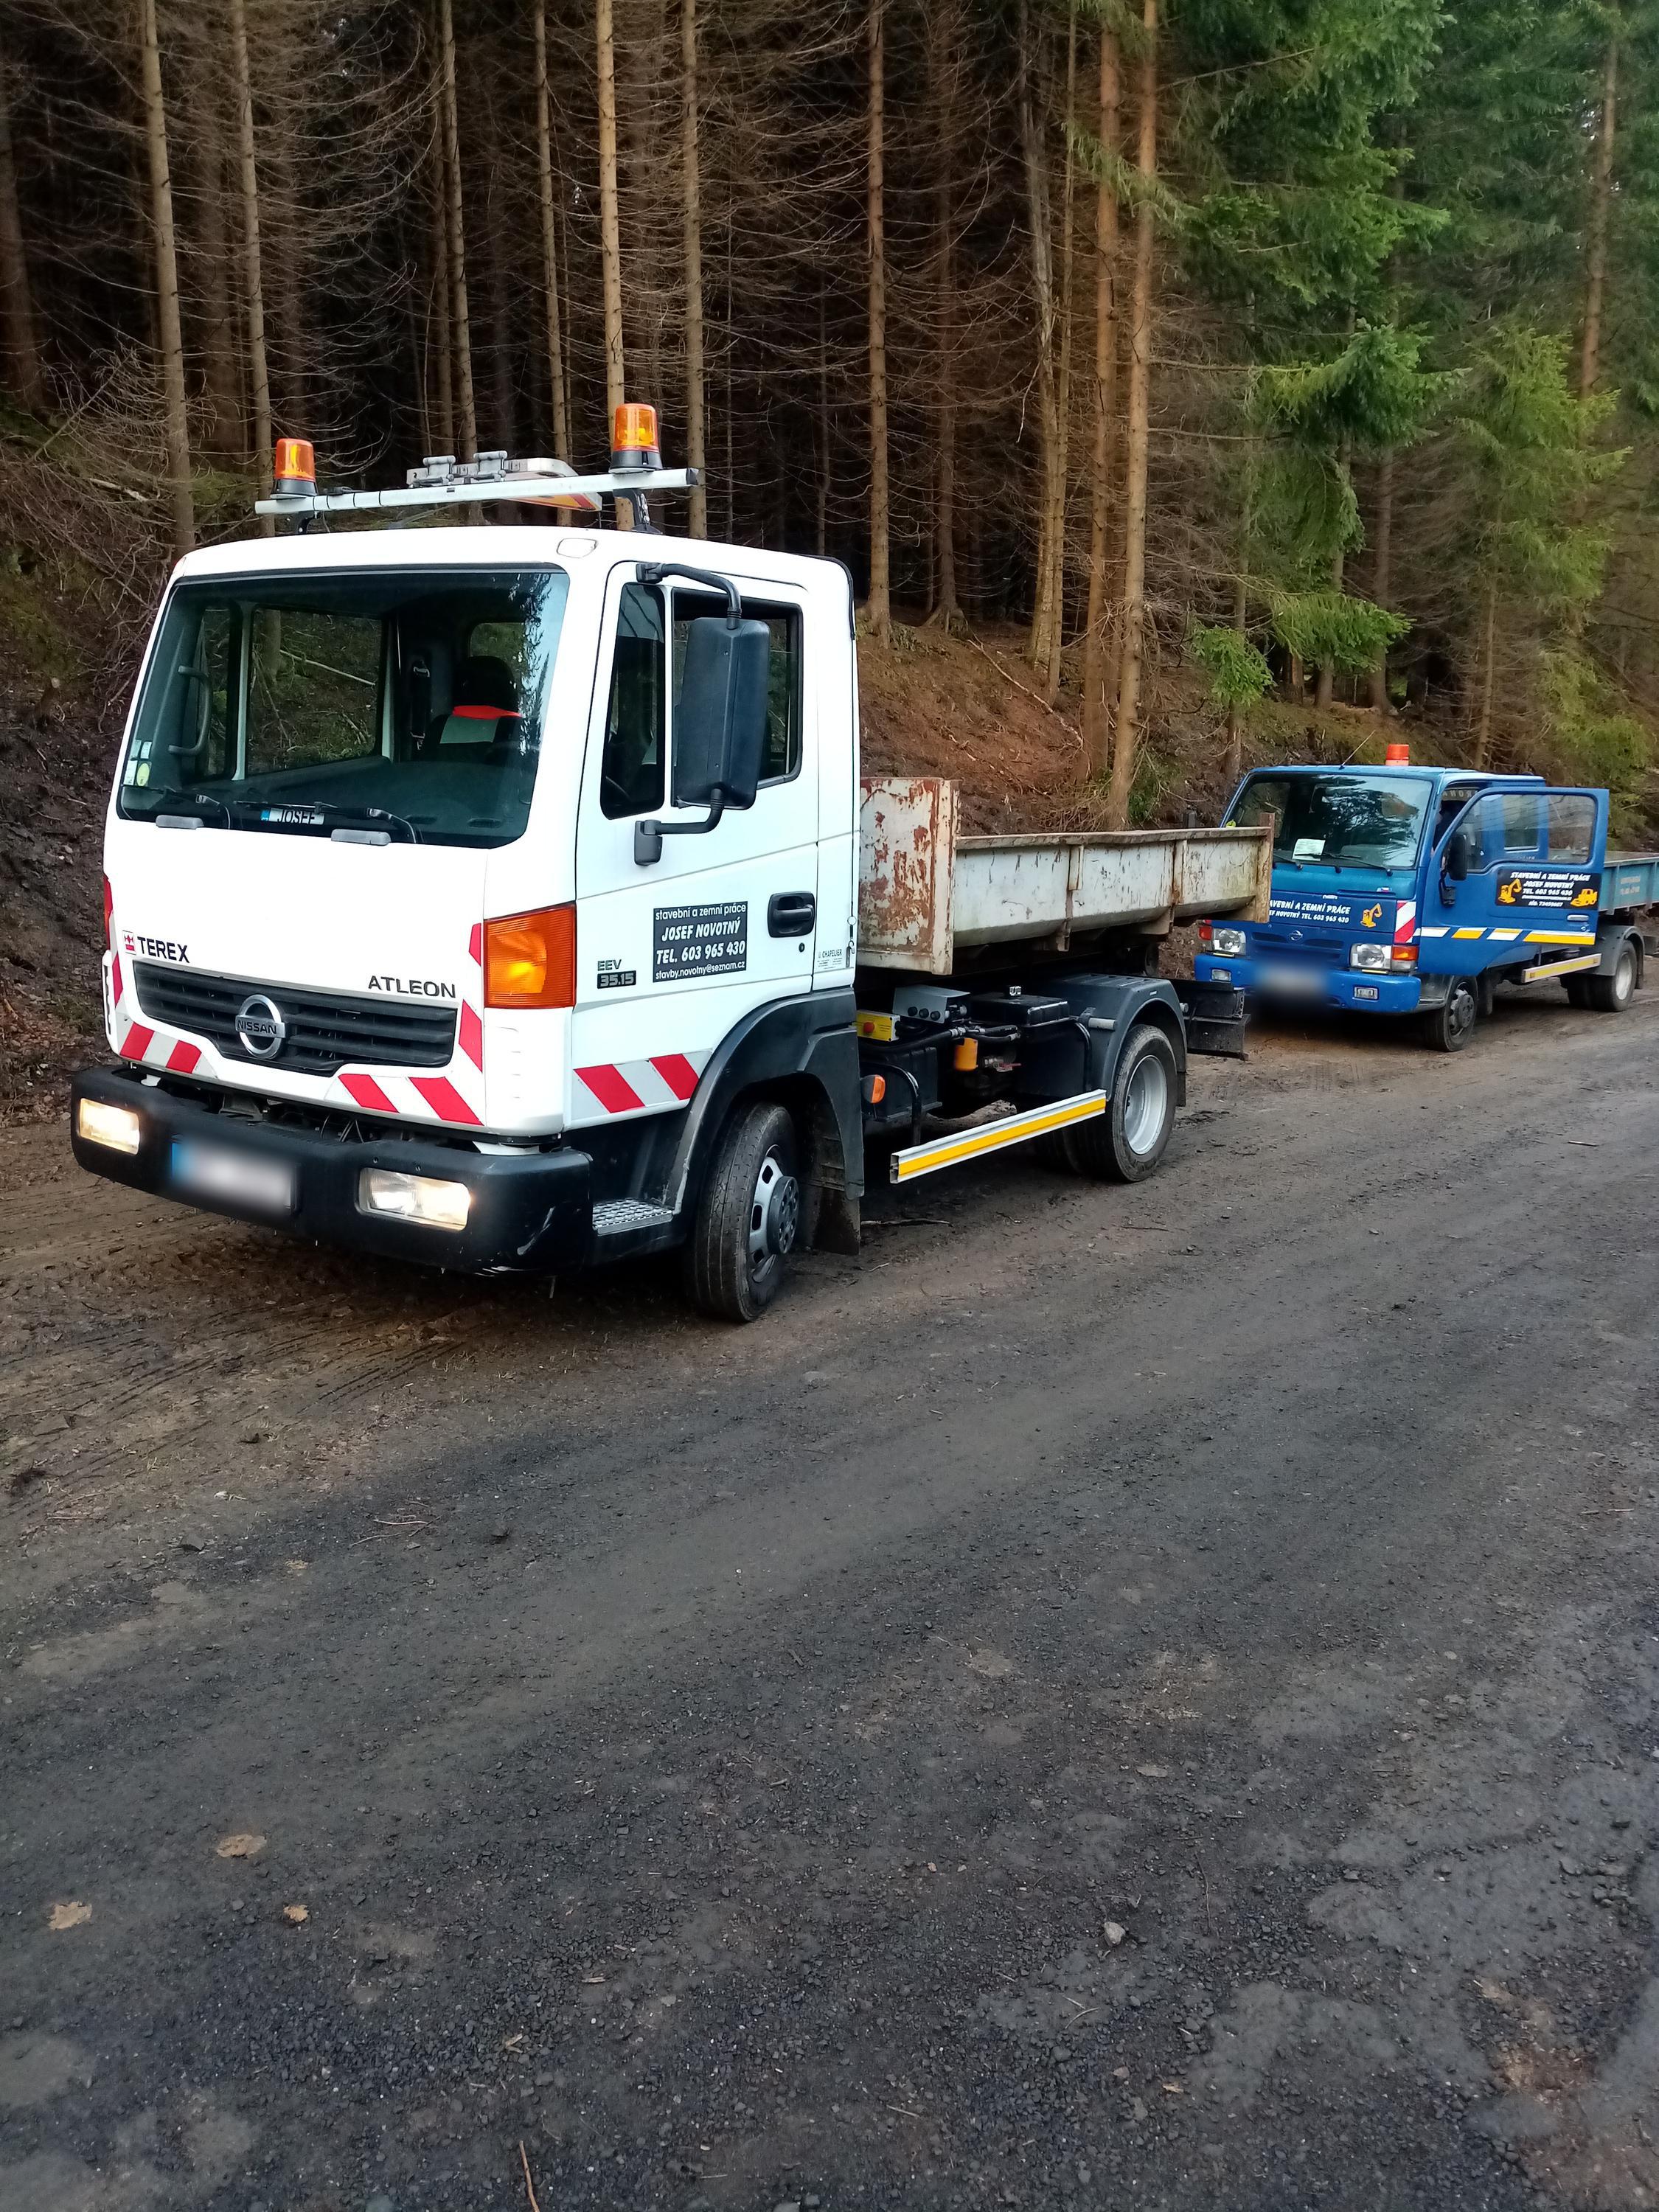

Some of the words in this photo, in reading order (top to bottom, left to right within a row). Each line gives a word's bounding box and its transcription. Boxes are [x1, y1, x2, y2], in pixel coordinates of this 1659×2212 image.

[655, 907, 691, 920] stavební
[692, 908, 698, 917] a
[699, 904, 723, 917] zemní
[724, 902, 746, 916] práce
[1270, 900, 1295, 909] AVEBNÍ
[1301, 902, 1326, 913] ZEMNÍ
[1326, 904, 1351, 915] PRÁCE
[1276, 910, 1301, 919] NOVOTNÝ
[661, 925, 694, 942] JOSEF
[695, 917, 740, 939] NOVOTNÝ
[137, 936, 190, 964] TEREX
[656, 948, 678, 965] TEL.
[681, 945, 702, 961] 603
[705, 943, 724, 960] 965
[726, 940, 745, 956] 430
[598, 959, 622, 971] EEV
[655, 961, 745, 980] stavby.novotny@seznam.cz
[368, 975, 456, 998] ATLEON
[600, 973, 634, 987] 35.15
[237, 1020, 276, 1034] NISSAN
